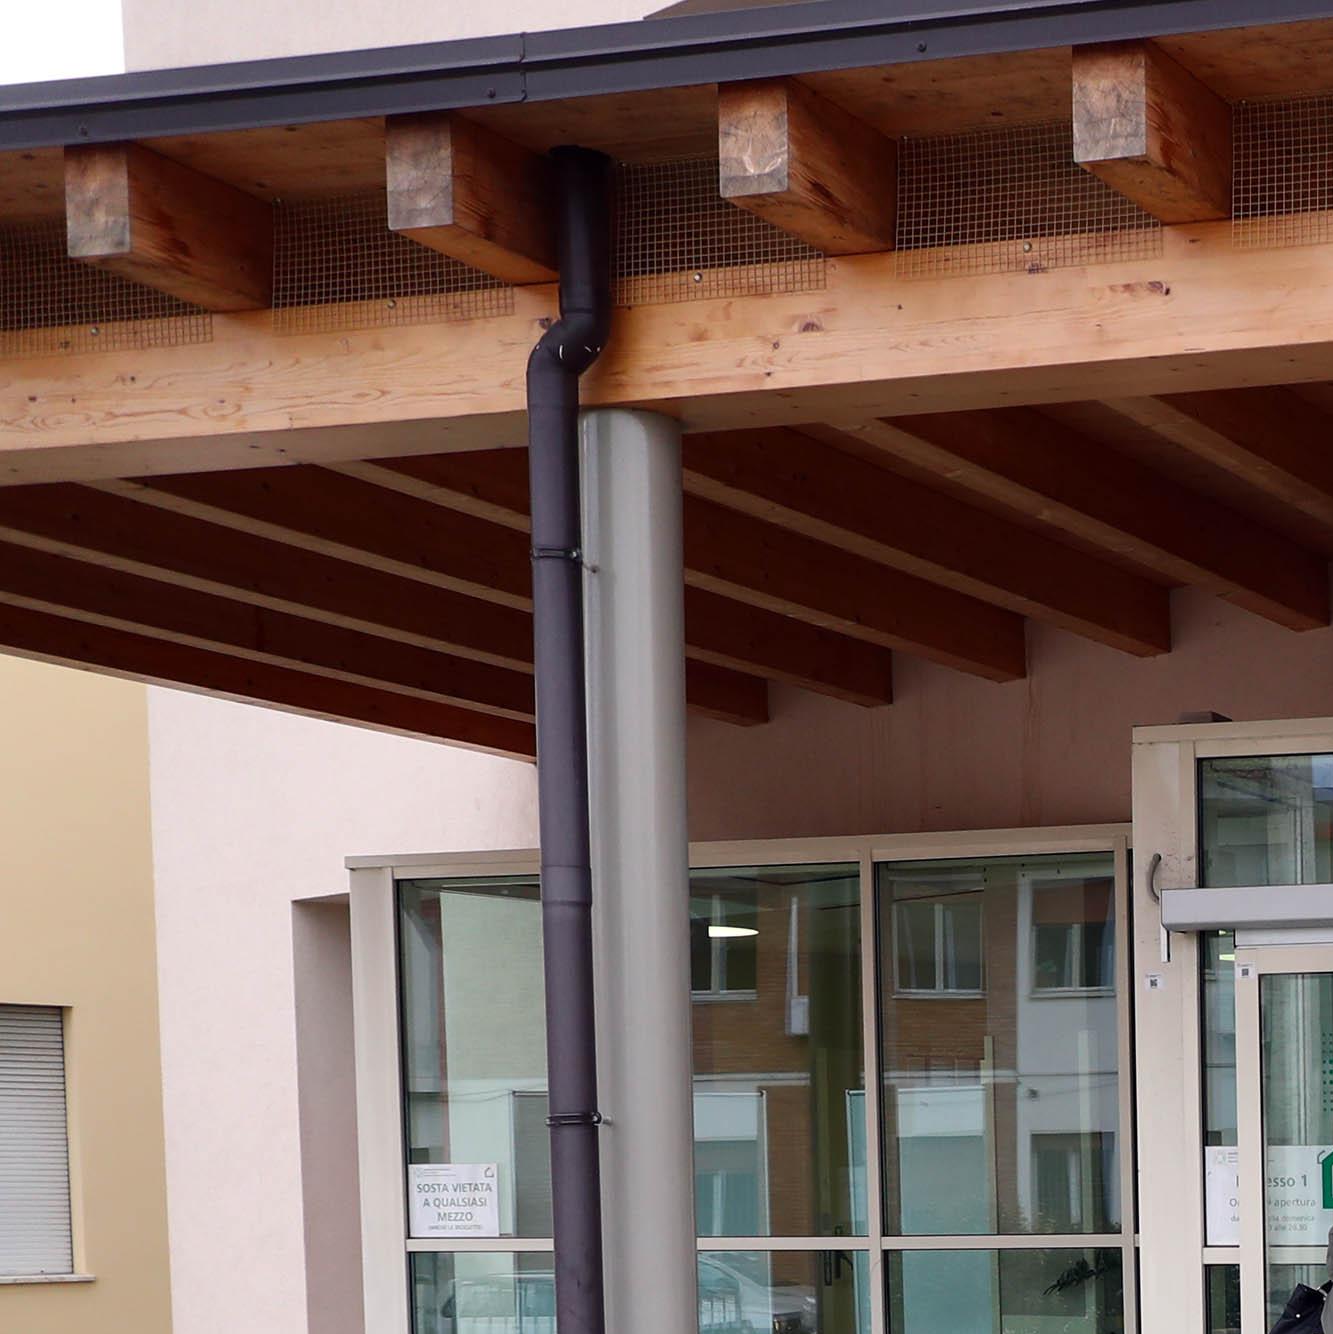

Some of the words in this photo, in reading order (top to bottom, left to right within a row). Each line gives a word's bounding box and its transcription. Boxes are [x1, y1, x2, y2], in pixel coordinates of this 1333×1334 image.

[416, 1183, 450, 1193] SOSTA
[451, 1182, 493, 1192] VIETATA
[1236, 1175, 1295, 1190] Iesso
[1301, 1174, 1307, 1187] 1
[423, 1197, 431, 1208] A
[433, 1197, 488, 1208] QUALSIASI
[437, 1211, 473, 1222] MEZZO
